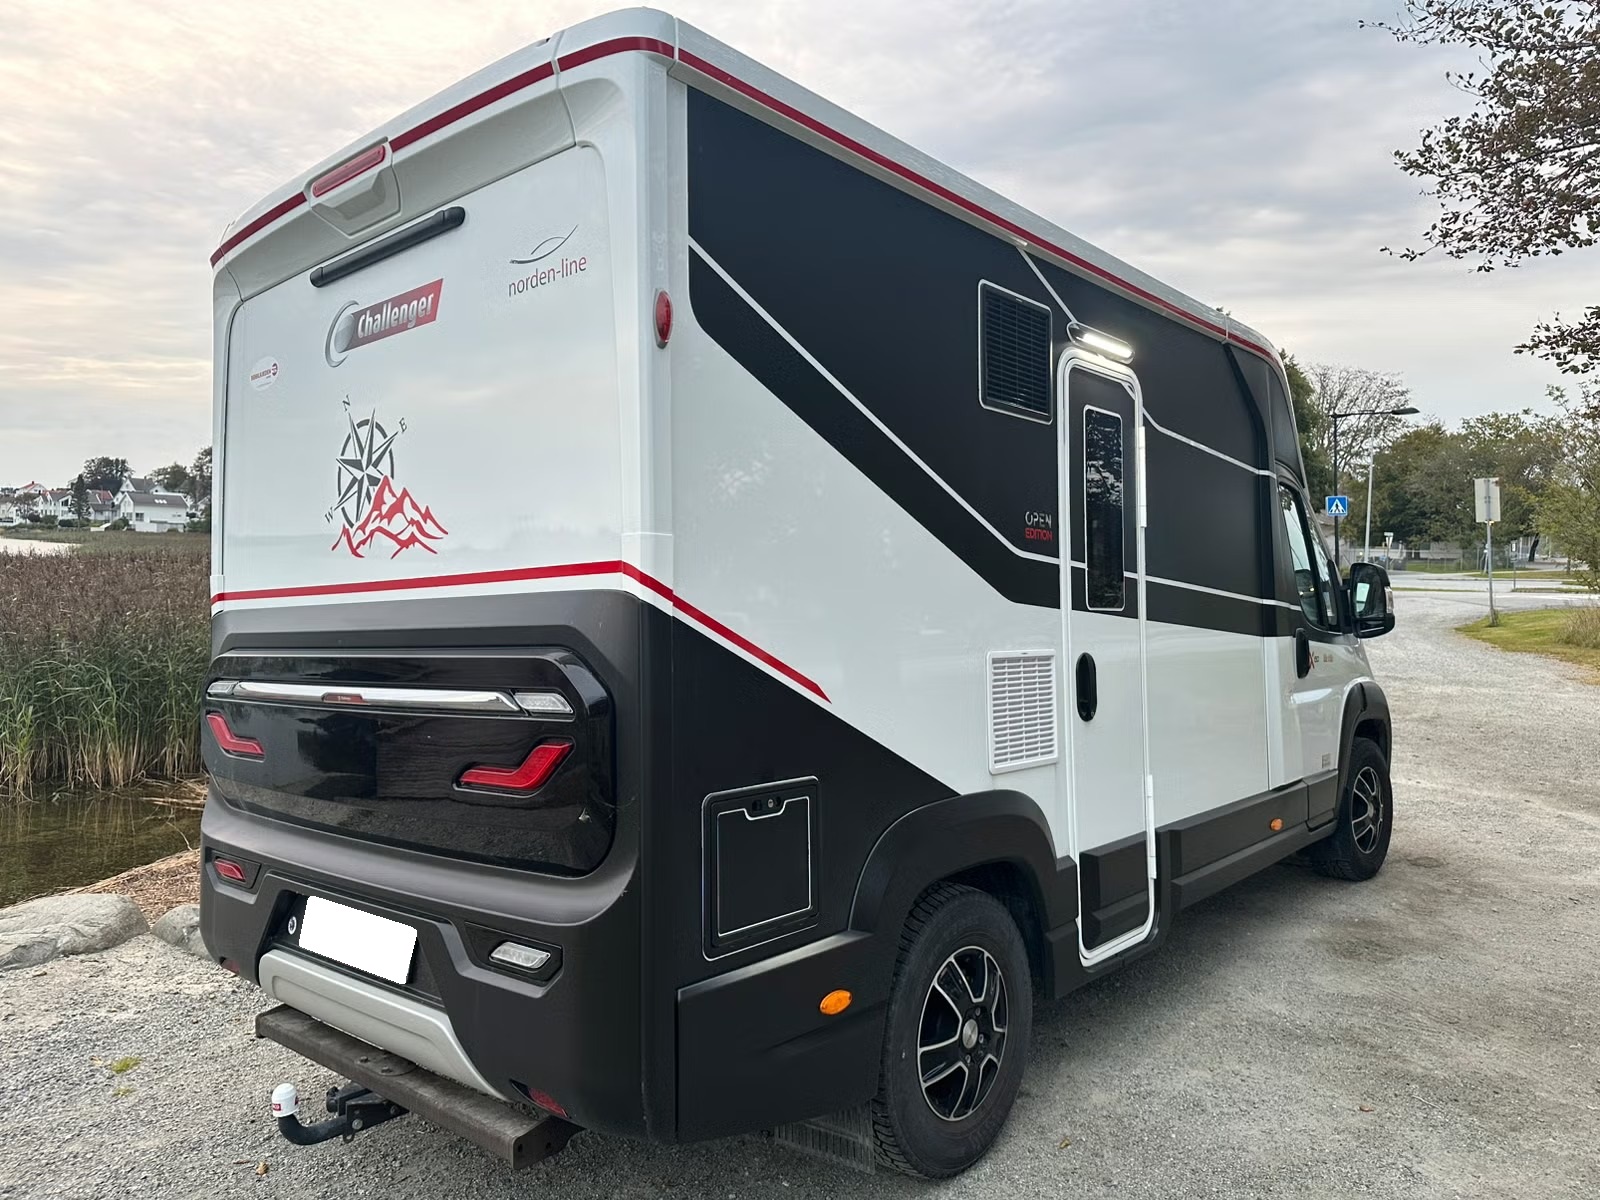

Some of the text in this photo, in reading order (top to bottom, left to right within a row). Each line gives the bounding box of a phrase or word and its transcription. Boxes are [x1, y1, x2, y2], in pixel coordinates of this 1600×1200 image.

[508, 256, 587, 297] norden-line
[357, 292, 434, 338] Challenger
[342, 394, 351, 411] N
[399, 417, 408, 433] E
[324, 507, 334, 524] W
[1025, 511, 1052, 528] OPEN
[1025, 527, 1053, 541] EDITION
